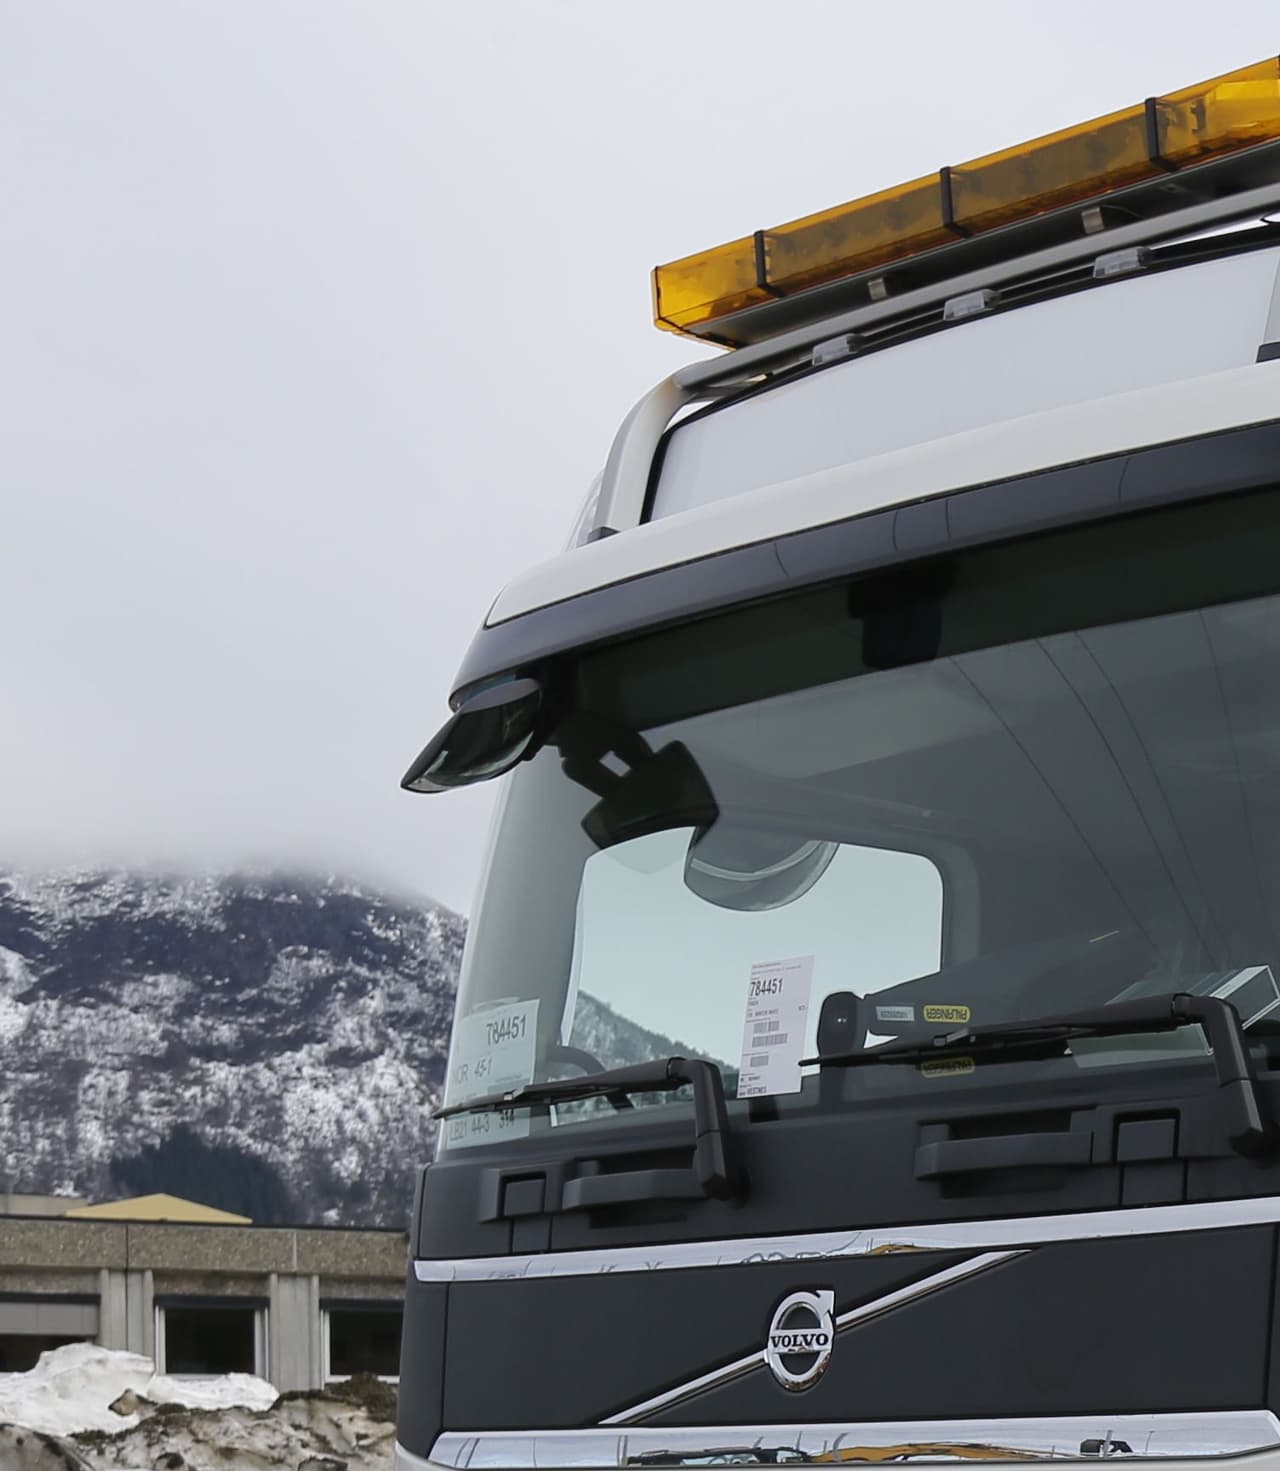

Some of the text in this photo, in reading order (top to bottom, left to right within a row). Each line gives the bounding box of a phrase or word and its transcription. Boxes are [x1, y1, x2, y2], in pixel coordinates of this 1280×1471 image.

[749, 977, 783, 997] 784451
[486, 1014, 527, 1046] 784451
[770, 1333, 829, 1348] VOLVO
